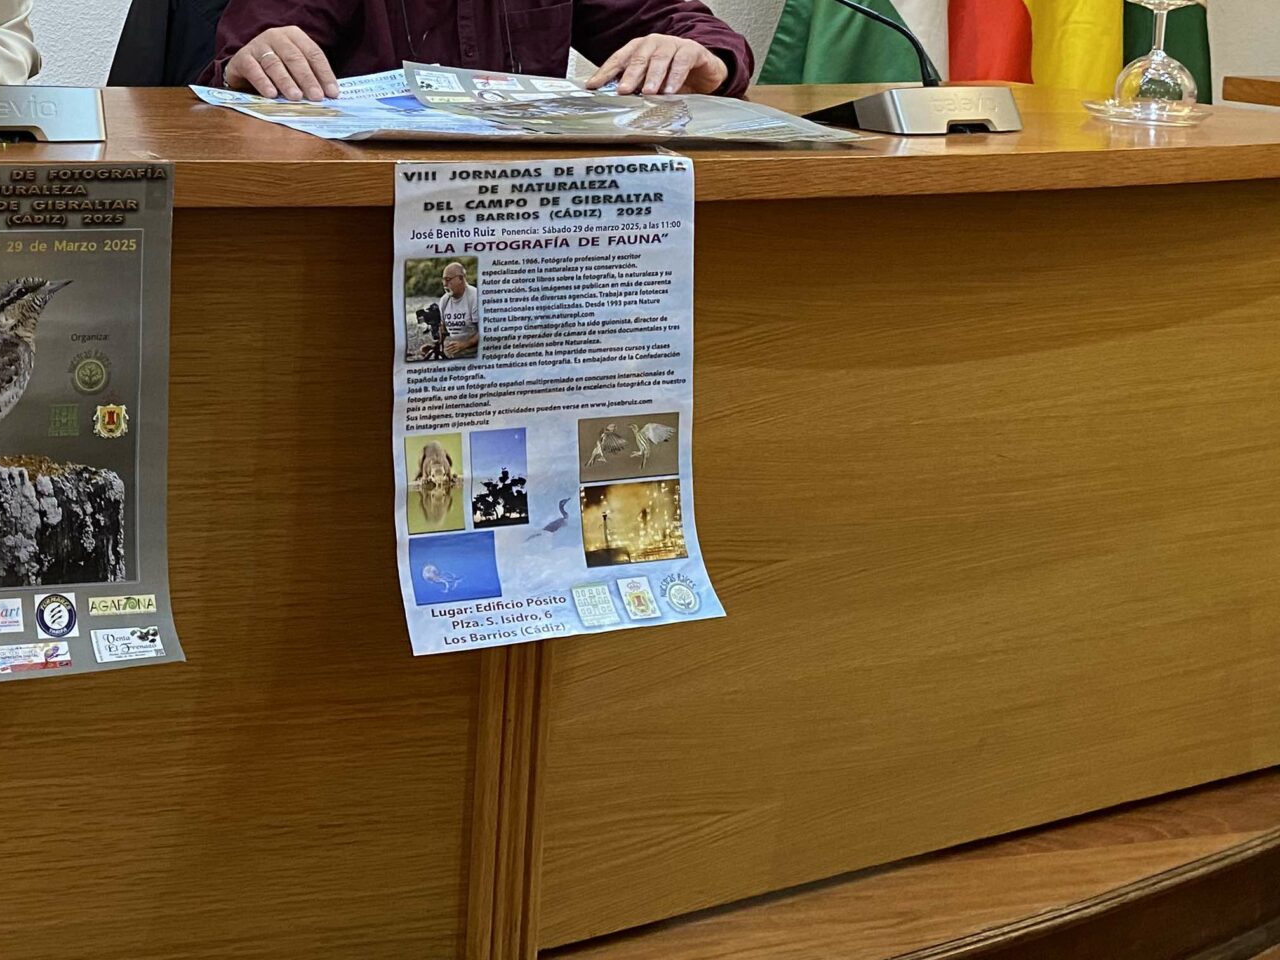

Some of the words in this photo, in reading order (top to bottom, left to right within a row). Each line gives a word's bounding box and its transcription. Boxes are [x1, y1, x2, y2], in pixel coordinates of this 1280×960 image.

[9, 169, 37, 181] DE
[45, 167, 168, 181] FOTOGRAFÍA
[402, 171, 436, 182] VIII
[448, 168, 542, 181] JORNADAS
[553, 166, 574, 177] DE
[585, 161, 687, 175] FOTOGRAFÍA
[478, 184, 498, 195] DE
[510, 180, 620, 193] NATURALEZA
[29, 199, 140, 211] GIBRALTAR
[423, 201, 453, 212] DEL
[464, 198, 528, 210] CAMPO
[539, 196, 560, 207] DE
[570, 192, 663, 206] GIBRALTAR
[4, 213, 68, 225] (CÁDIZ)
[80, 213, 126, 224] 2025
[439, 214, 466, 224] LOS
[475, 211, 540, 222] BARRIOS
[549, 208, 602, 220] (CÁDIZ)
[616, 206, 652, 216] 2025
[410, 228, 434, 240] José
[435, 228, 471, 239] Benito
[472, 227, 496, 237] Ruiz
[500, 226, 539, 236] Ponencia:
[541, 225, 572, 234] Sábado
[572, 225, 583, 233] 29
[583, 224, 594, 232] de
[620, 222, 642, 231] 2025,
[648, 221, 659, 229] las
[6, 241, 23, 252] 29
[29, 241, 47, 252] de
[54, 240, 97, 252] Marzo
[104, 240, 137, 251] 2025
[426, 244, 455, 254] “LA
[463, 237, 570, 253] FOTOGRAFÍA
[578, 236, 599, 247] DE
[607, 233, 668, 246] FAUNA”
[430, 603, 473, 618] Lugar:
[475, 598, 524, 615] Edificio
[525, 596, 568, 607] Pósito
[450, 617, 483, 630] Plza.
[485, 616, 498, 626] S.
[500, 613, 541, 624] Isidro,
[543, 610, 554, 618] 6
[443, 636, 467, 645] Los
[468, 627, 517, 643] Barrios
[520, 621, 568, 638] (Cádiz)
